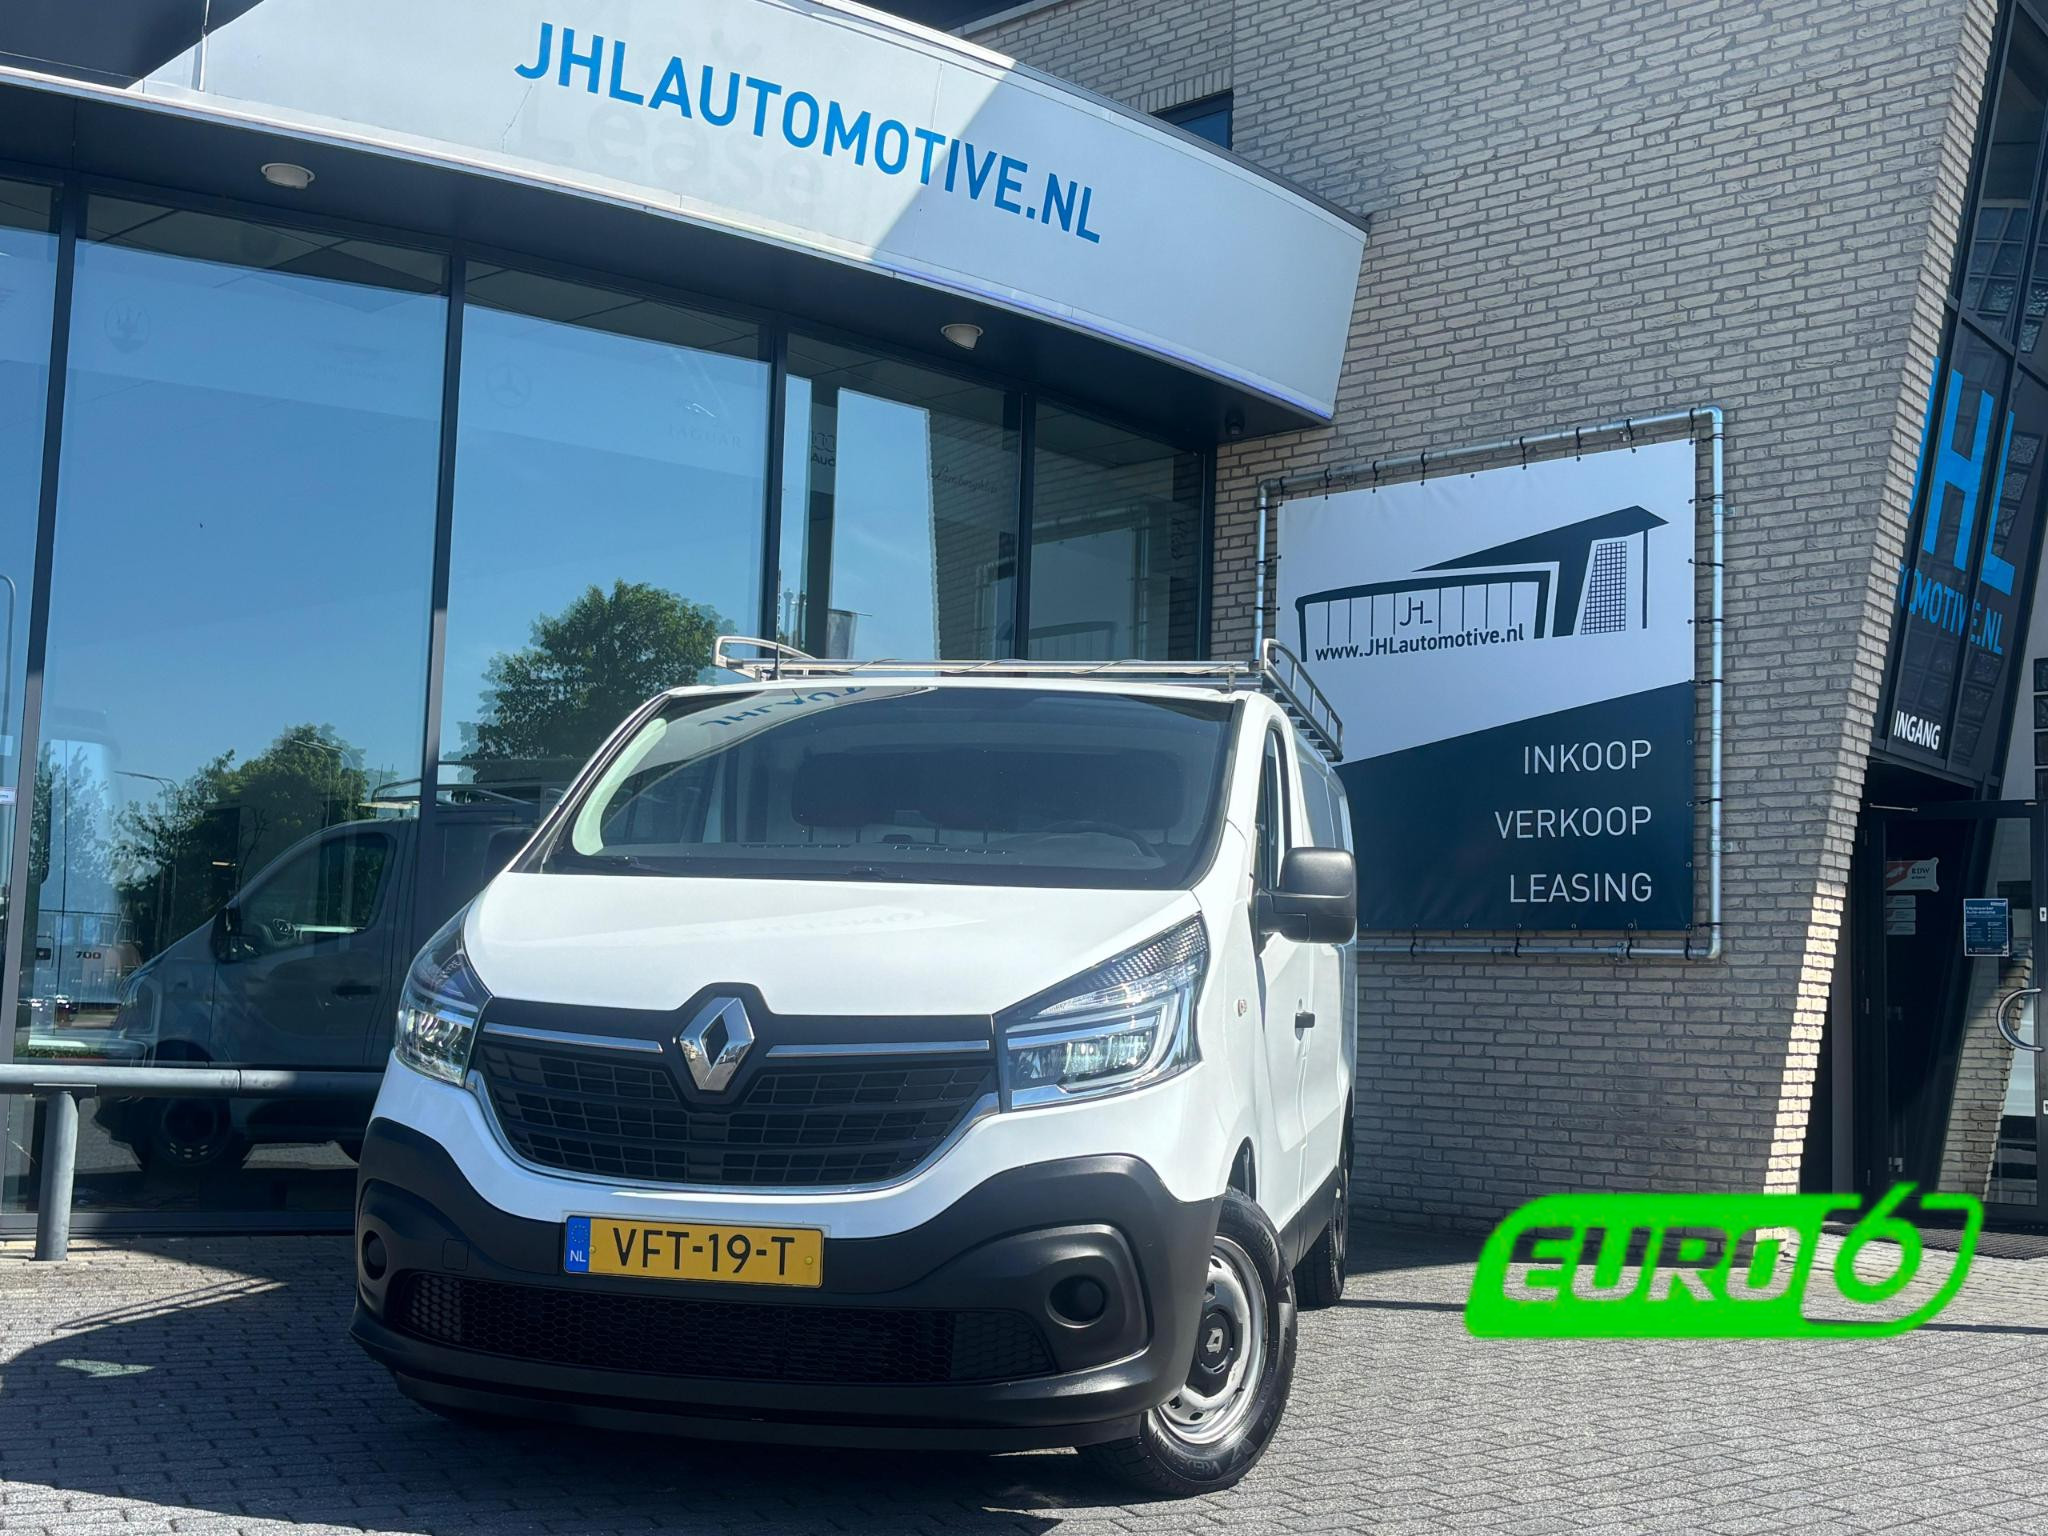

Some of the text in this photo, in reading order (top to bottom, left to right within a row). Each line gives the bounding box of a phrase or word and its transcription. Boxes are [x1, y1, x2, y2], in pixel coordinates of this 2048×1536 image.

[514, 22, 1101, 244] JHLAUTOMOTIVE.NL
[811, 453, 837, 467] Aud
[1908, 356, 2016, 596] HL
[1315, 623, 1525, 661] www.JHLautomotive.nl
[1893, 710, 1942, 751] INGANG
[1524, 739, 1652, 774] INKOOP
[1494, 806, 1652, 839] VERKOOP
[1510, 872, 1652, 903] LEASING
[74, 950, 102, 960] 700
[569, 1249, 587, 1263] NL
[612, 1227, 796, 1276] VFT-19-T
